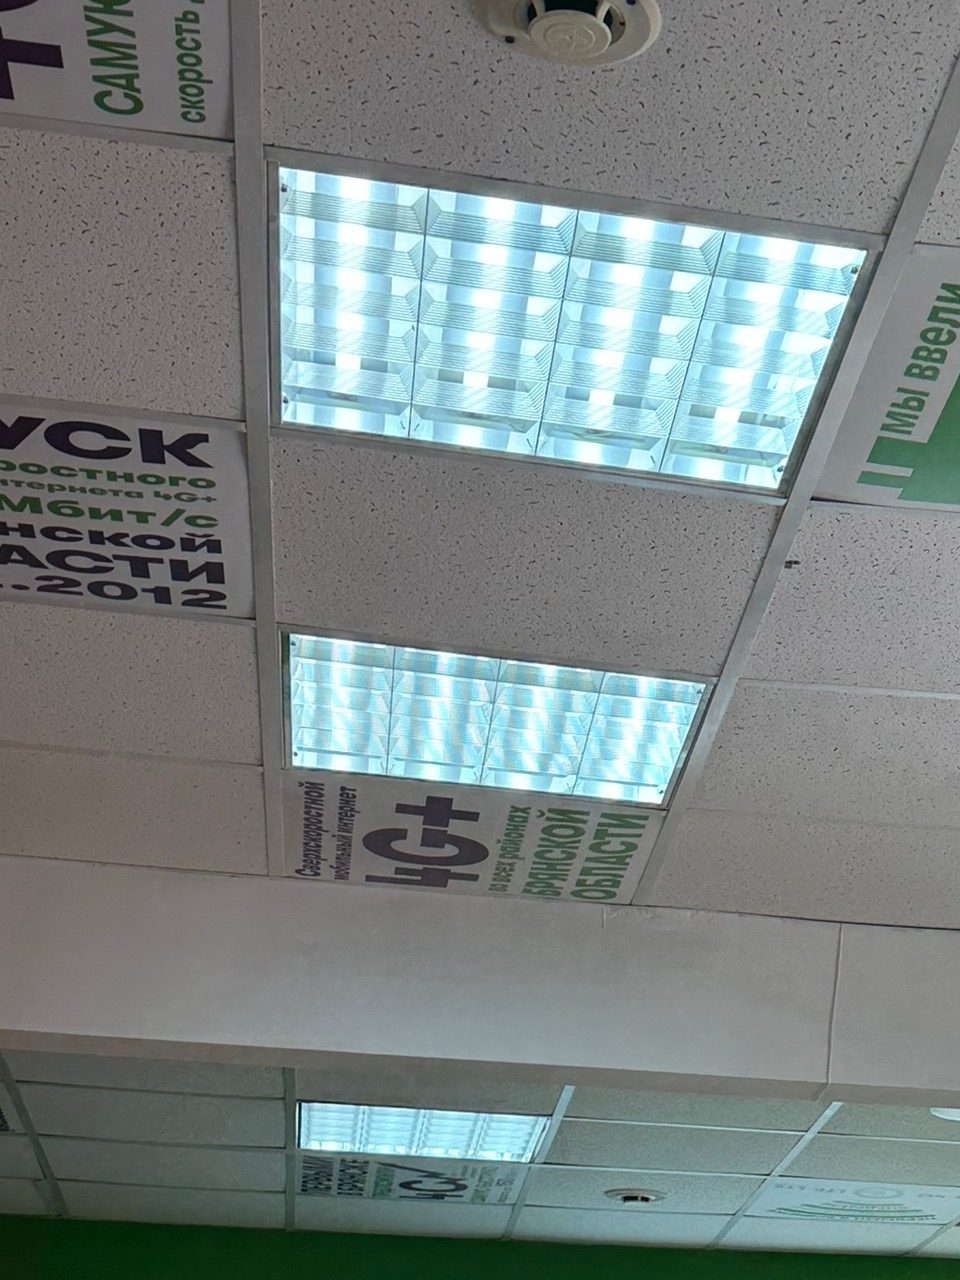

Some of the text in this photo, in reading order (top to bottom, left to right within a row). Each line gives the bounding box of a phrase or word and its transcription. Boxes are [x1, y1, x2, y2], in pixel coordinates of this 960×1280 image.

[174, 10, 213, 123] скорость
[295, 781, 329, 877] Сверхскоростной
[337, 786, 361, 834] интернет
[362, 796, 489, 888] 4G+
[496, 805, 532, 861] районах
[522, 808, 591, 897] БРЯНСКОЙ
[570, 812, 649, 900] ОБЛАСТИ
